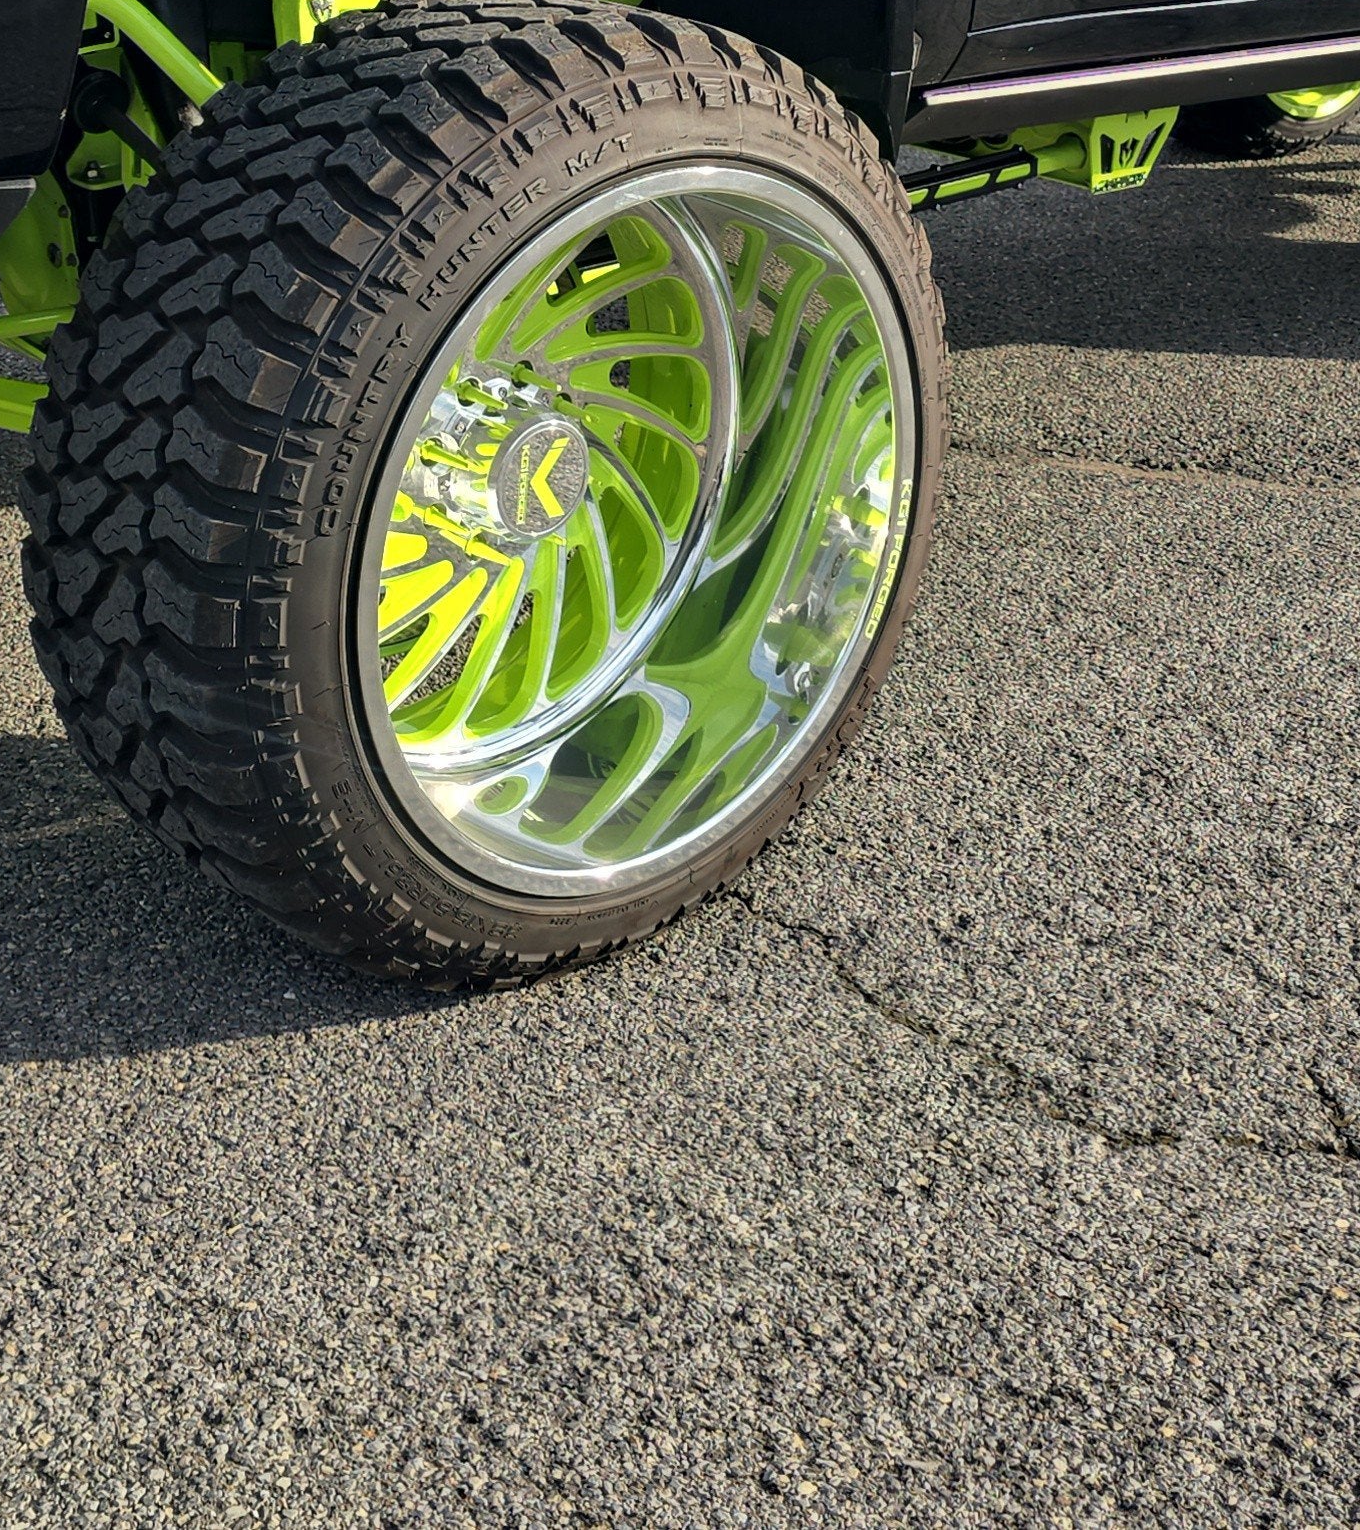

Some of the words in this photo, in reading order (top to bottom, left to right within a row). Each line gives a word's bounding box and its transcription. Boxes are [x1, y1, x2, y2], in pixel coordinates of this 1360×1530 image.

[314, 321, 413, 537] COUNTRY
[415, 176, 552, 313] HUNTER
[562, 132, 633, 178] M/T
[864, 533, 905, 640] FORGED
